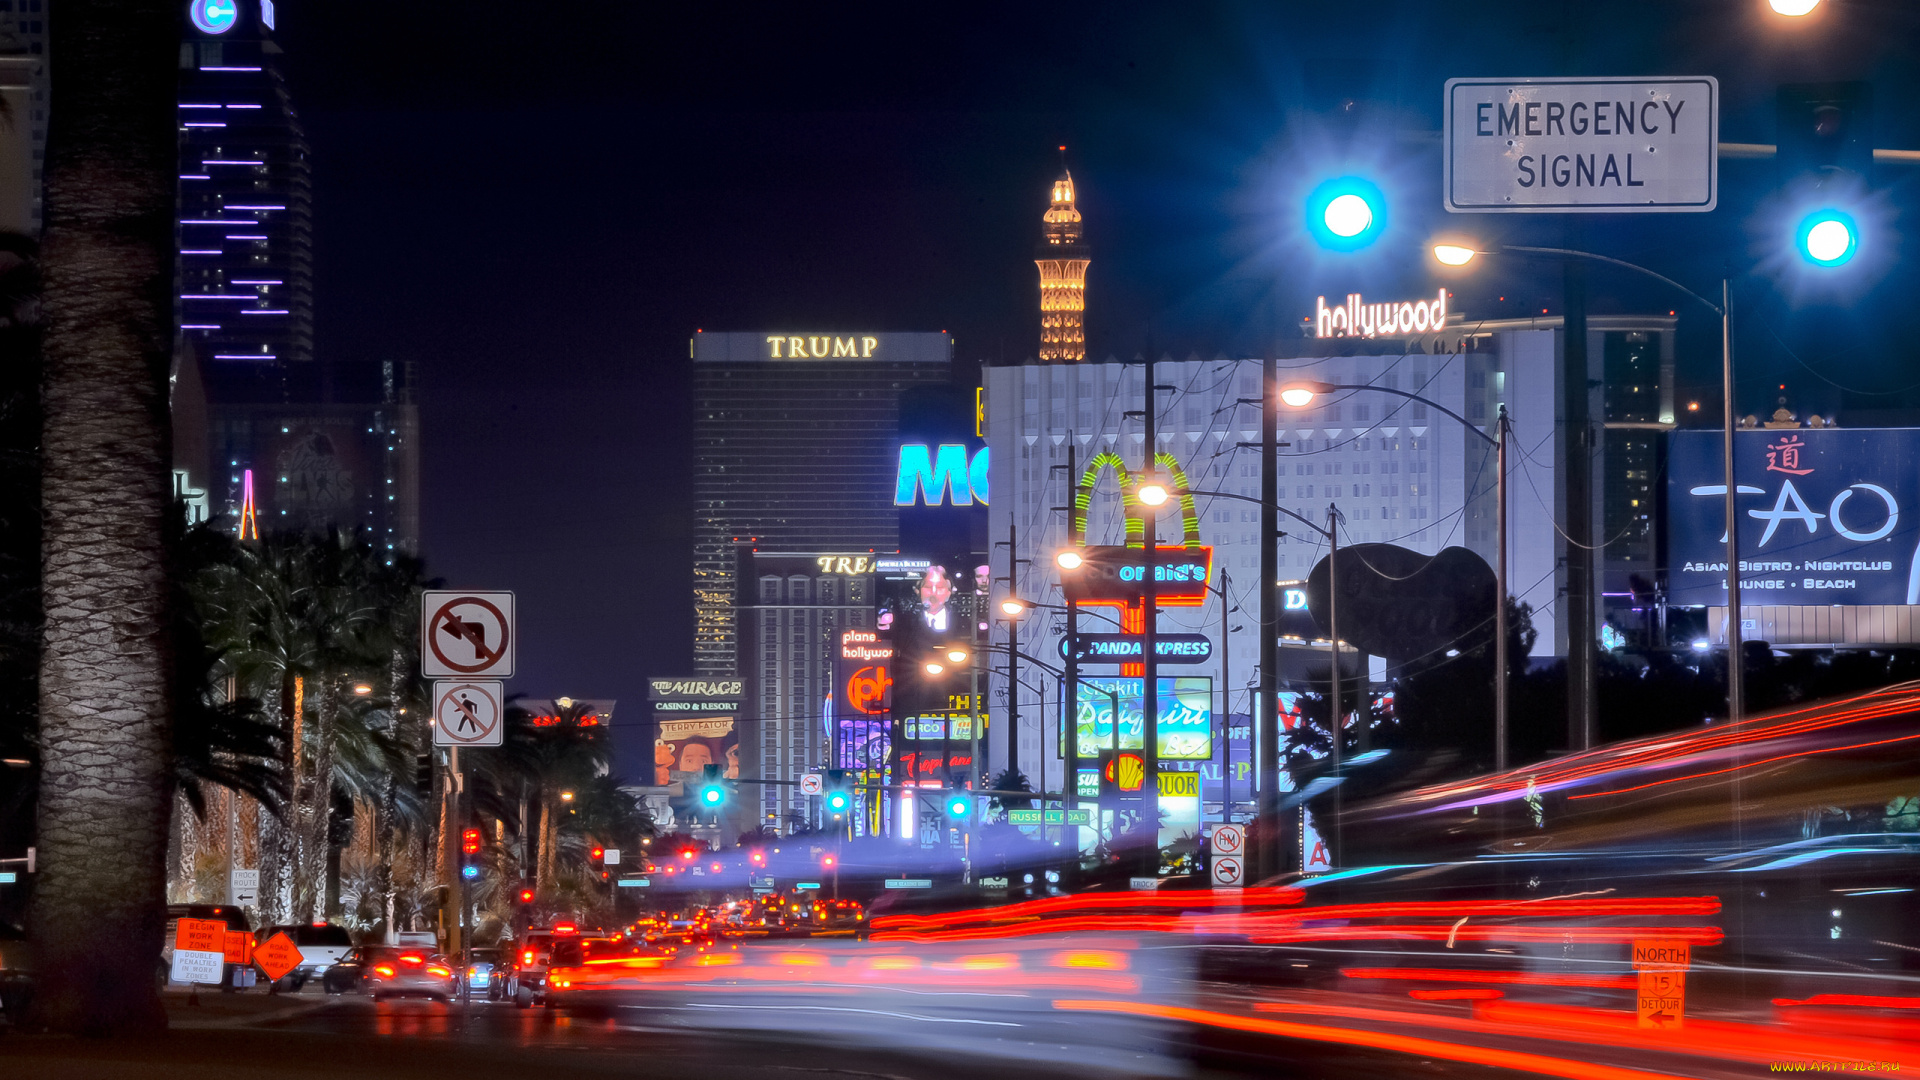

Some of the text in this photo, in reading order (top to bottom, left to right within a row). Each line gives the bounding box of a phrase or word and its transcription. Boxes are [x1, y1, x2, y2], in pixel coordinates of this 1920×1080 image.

[1476, 100, 1685, 136] EMERGENCY
[1517, 152, 1644, 187] SIGNAL
[1317, 287, 1446, 338] hollywood
[767, 336, 878, 358] TRUMP
[1766, 434, 1815, 476] 道
[1690, 479, 1899, 548] TAO
[1683, 561, 1892, 572] ASIAN BISTRO NIGHTCLUB
[1803, 579, 1856, 589] BEACH
[843, 629, 882, 644] plane
[1090, 642, 1210, 655] PANDA XPRESS
[672, 681, 742, 696] MIRAGE
[1084, 680, 1144, 696] Chakit
[692, 703, 700, 711] &
[665, 720, 729, 732] TERRY FATOR
[908, 723, 940, 733] ARCO
[1010, 813, 1056, 821] RUSSELL
[1219, 833, 1236, 846] HM
[1133, 880, 1155, 888] TRUCK
[189, 923, 215, 931] BEGIN
[189, 932, 213, 940] WORK
[188, 942, 212, 950] ZONE
[226, 937, 249, 946] SSELL
[226, 949, 242, 957] OAD
[269, 944, 289, 952] ROAD
[185, 951, 213, 960] DOUBLE
[268, 952, 288, 960] WORK
[1637, 948, 1686, 961] NORTH
[179, 958, 217, 967] PENALTIES
[264, 961, 290, 970] AHEAD
[185, 972, 209, 980] ZONES
[1655, 976, 1669, 990] 15
[1641, 999, 1680, 1010] DETOUR
